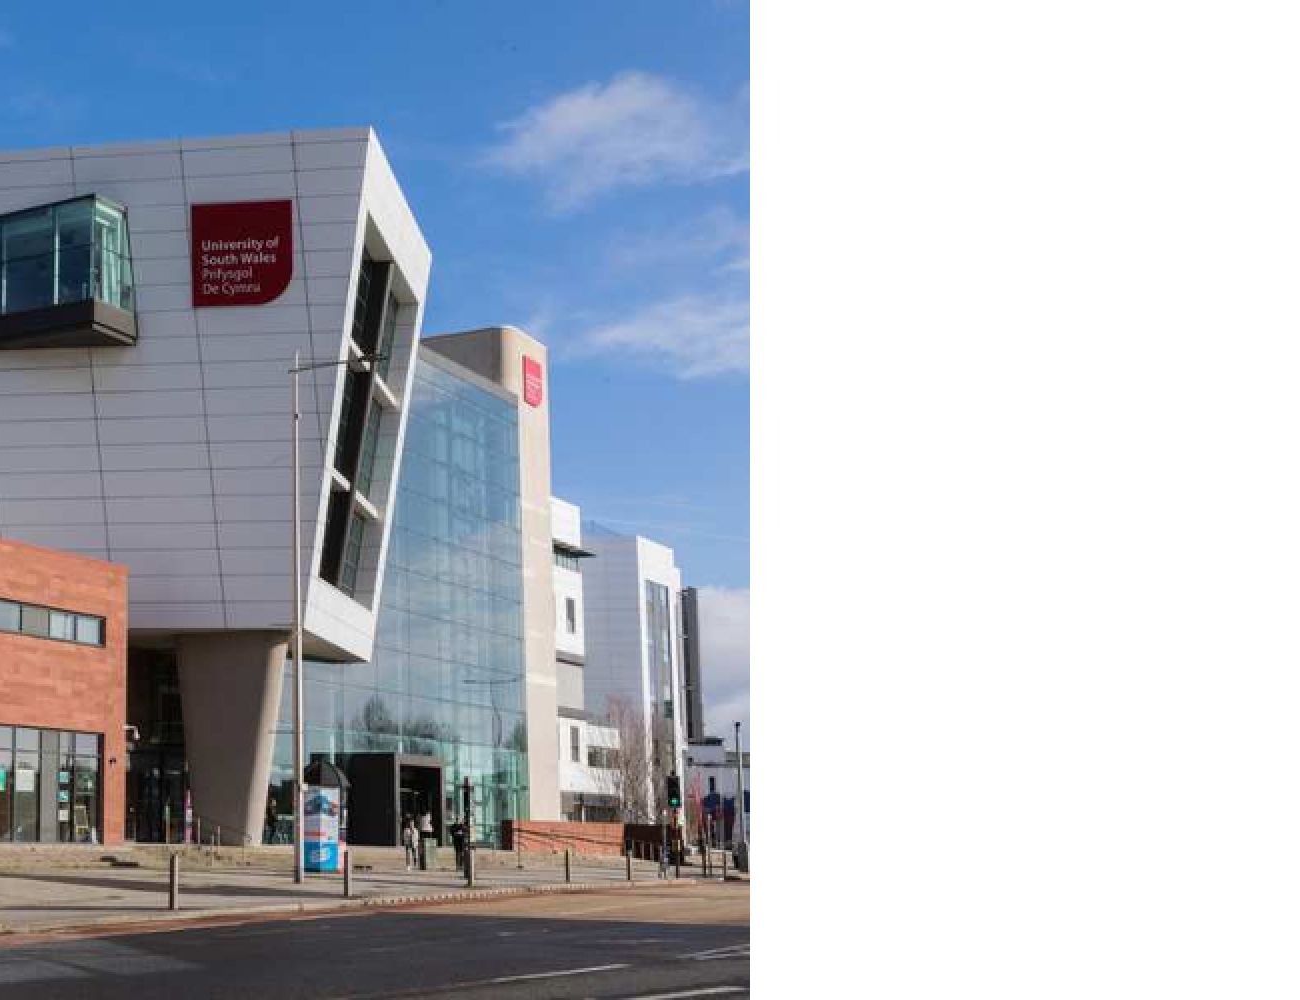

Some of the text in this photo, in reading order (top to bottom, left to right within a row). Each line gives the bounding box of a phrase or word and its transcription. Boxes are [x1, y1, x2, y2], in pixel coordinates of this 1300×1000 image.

[202, 236, 280, 251] University of
[202, 252, 276, 265] South Wales
[203, 267, 252, 281] Prifysgol
[203, 283, 261, 295] De Cymru
